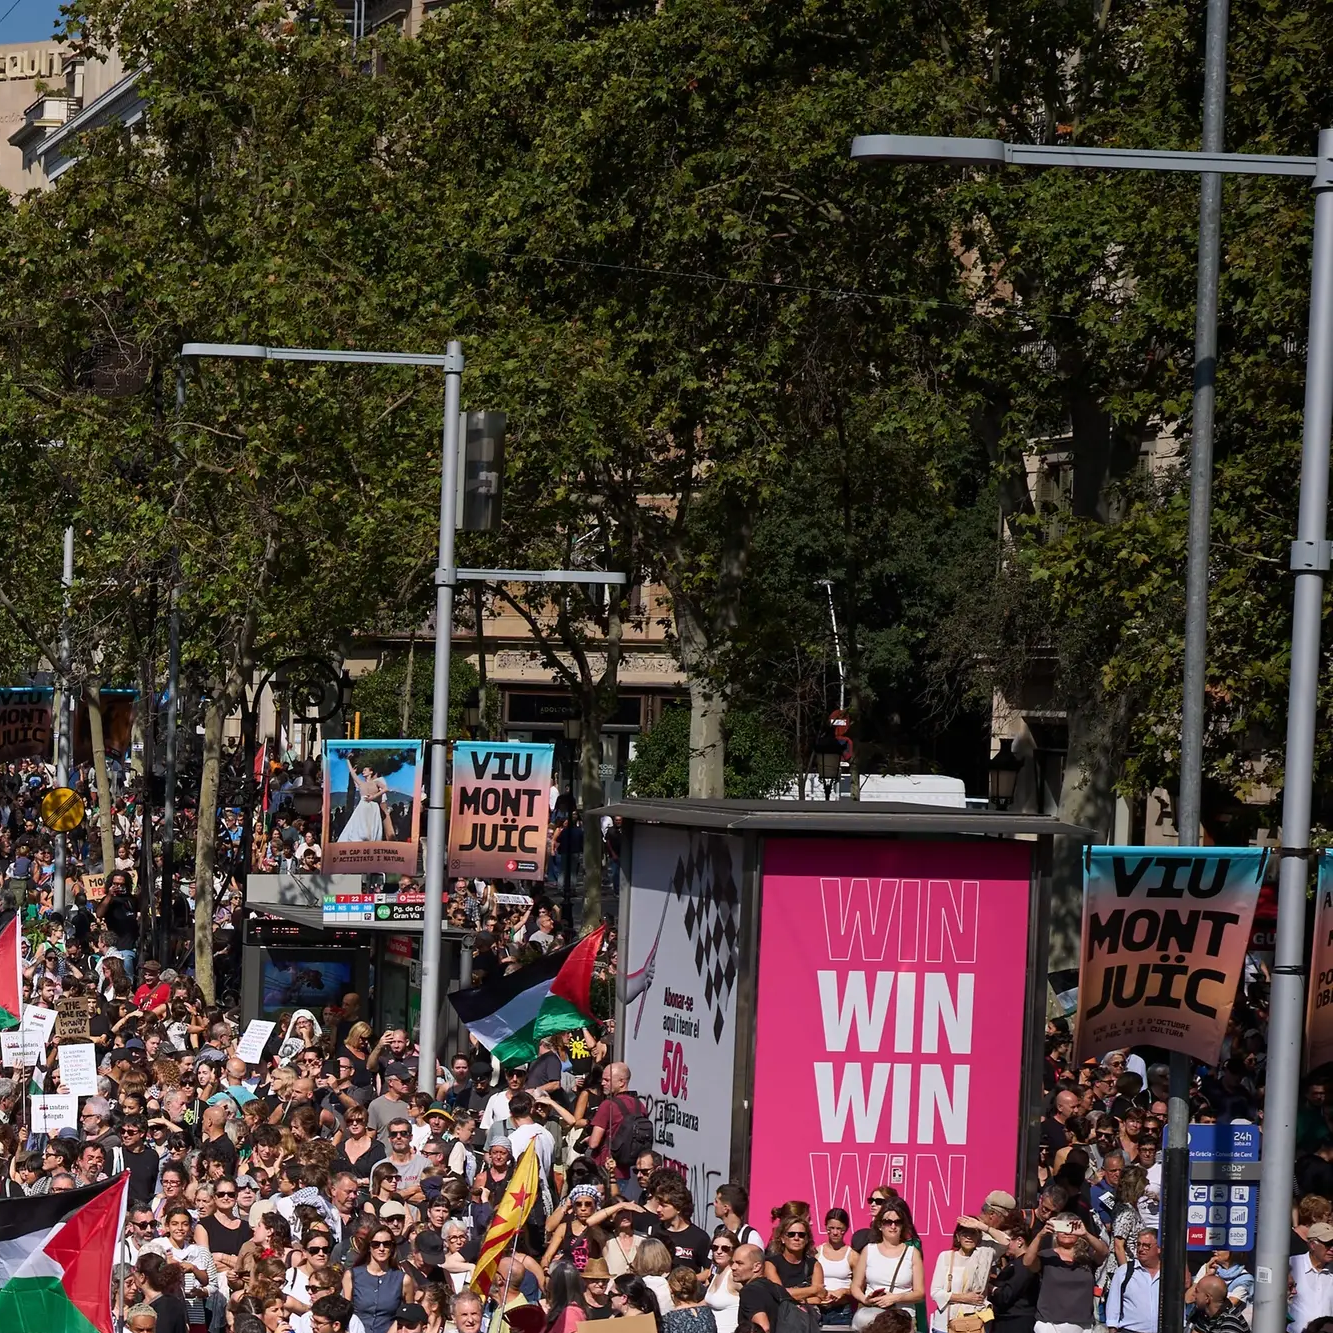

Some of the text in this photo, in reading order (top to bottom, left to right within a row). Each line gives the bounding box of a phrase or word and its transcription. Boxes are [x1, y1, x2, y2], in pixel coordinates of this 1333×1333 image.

[0, 692, 42, 706] VIU
[471, 752, 533, 781] VIU
[459, 787, 541, 818] MONT
[459, 819, 538, 854] JUÏC
[1112, 856, 1231, 899] VIU
[377, 907, 390, 915] V15
[393, 905, 403, 913] Pg.
[820, 877, 980, 963] WIN
[1088, 909, 1240, 962] MONT
[663, 986, 694, 1012] Abonar-se
[1086, 954, 1226, 1021] JUÏC
[58, 1009, 87, 1019] TIME FOR
[65, 1001, 80, 1010] THE
[817, 969, 975, 1054] WIN
[69, 1027, 86, 1036] OVER
[693, 1018, 700, 1038] el
[1147, 1018, 1191, 1032] D'OCTUBRE
[1150, 1026, 1184, 1038] CULTURA
[813, 1061, 971, 1145] WIN
[1233, 1131, 1252, 1141] 24h
[1222, 1164, 1242, 1173] saba
[809, 1152, 967, 1235] WIN
